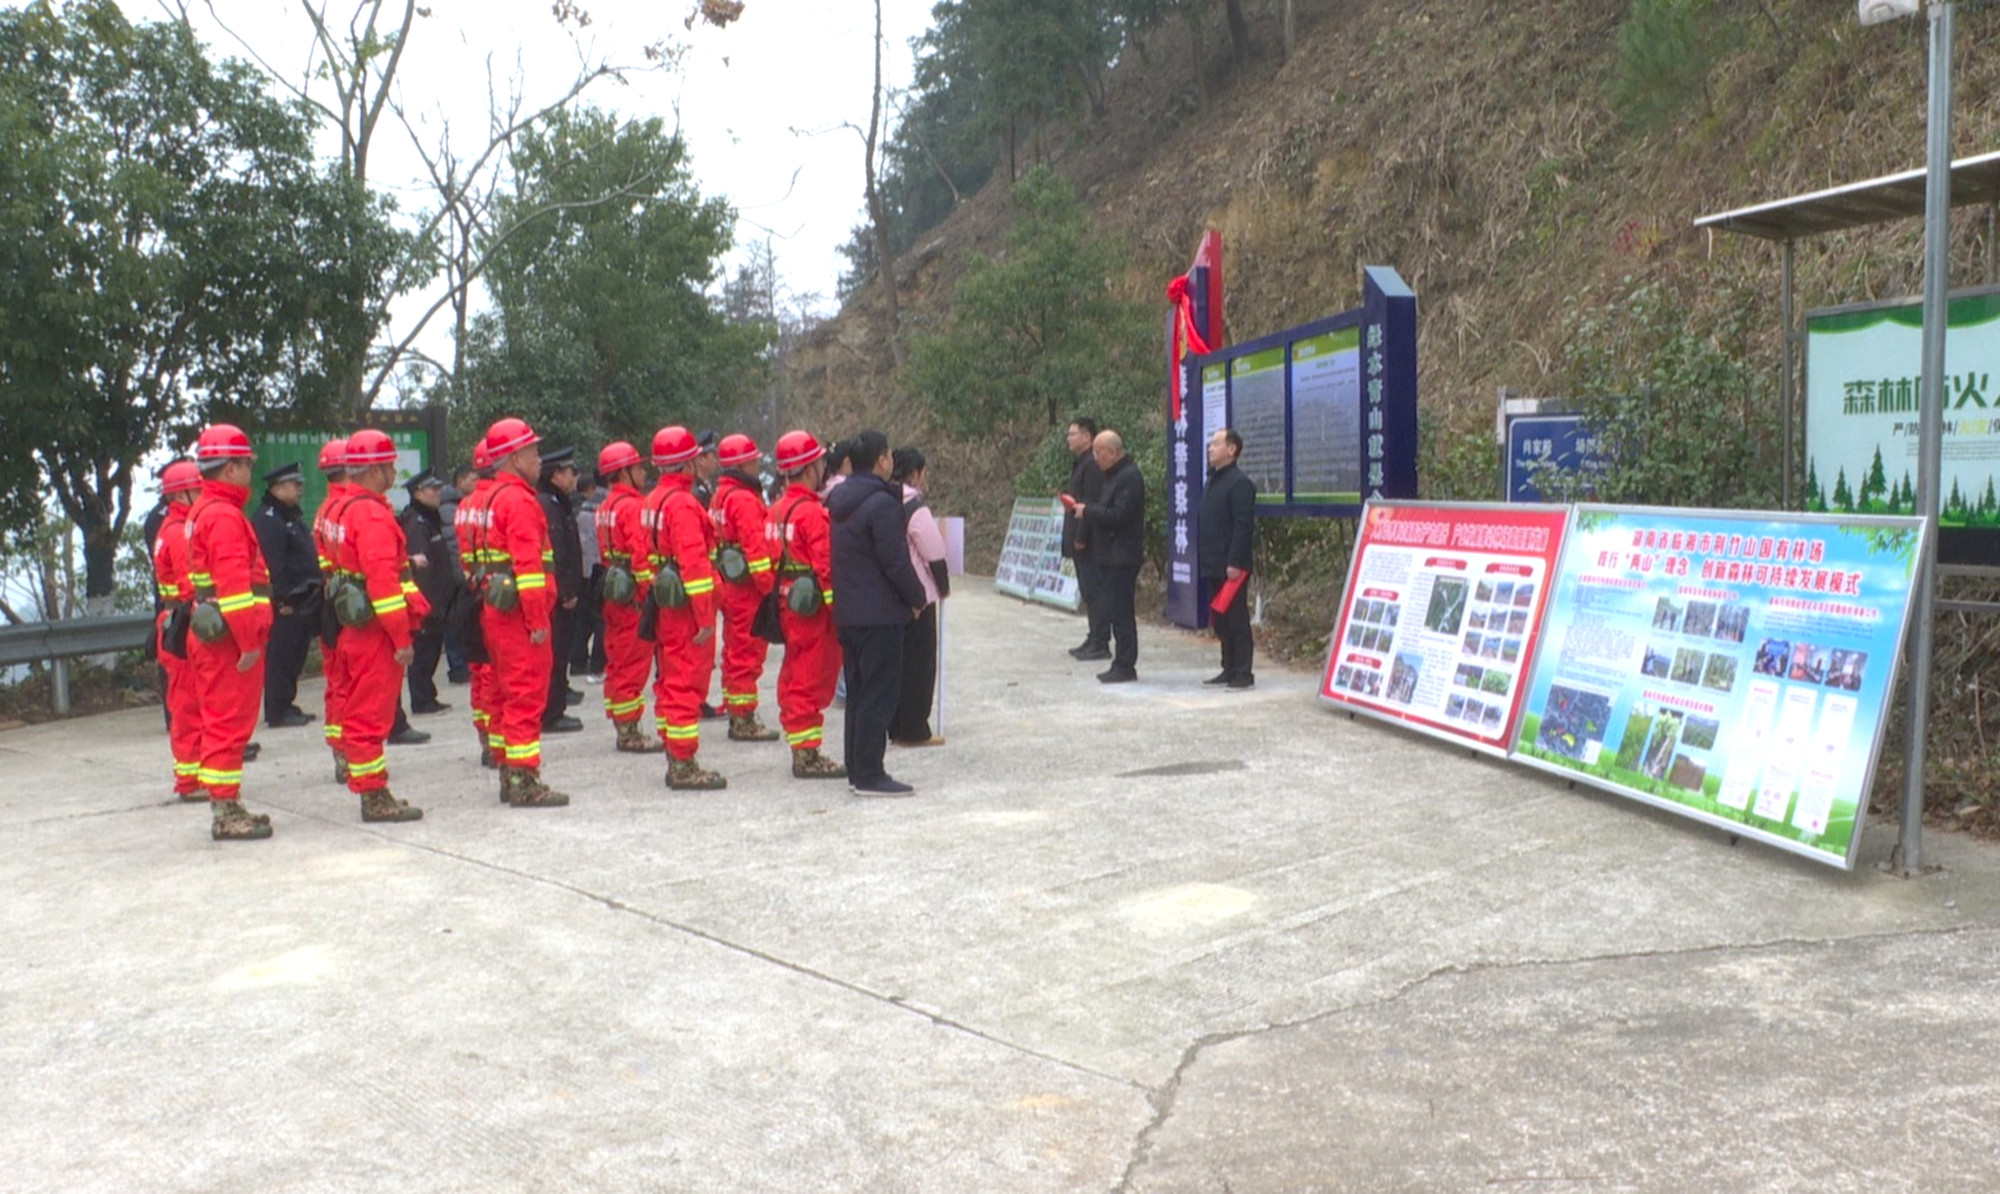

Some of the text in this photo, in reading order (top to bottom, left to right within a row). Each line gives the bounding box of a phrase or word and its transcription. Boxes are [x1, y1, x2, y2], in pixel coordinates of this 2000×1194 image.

[1843, 371, 2000, 415] 森林火
[1632, 529, 1824, 562] 湖南省临湘市荆竹山国有林场
[1701, 556, 1861, 595] 创新森林可持续发展模式
